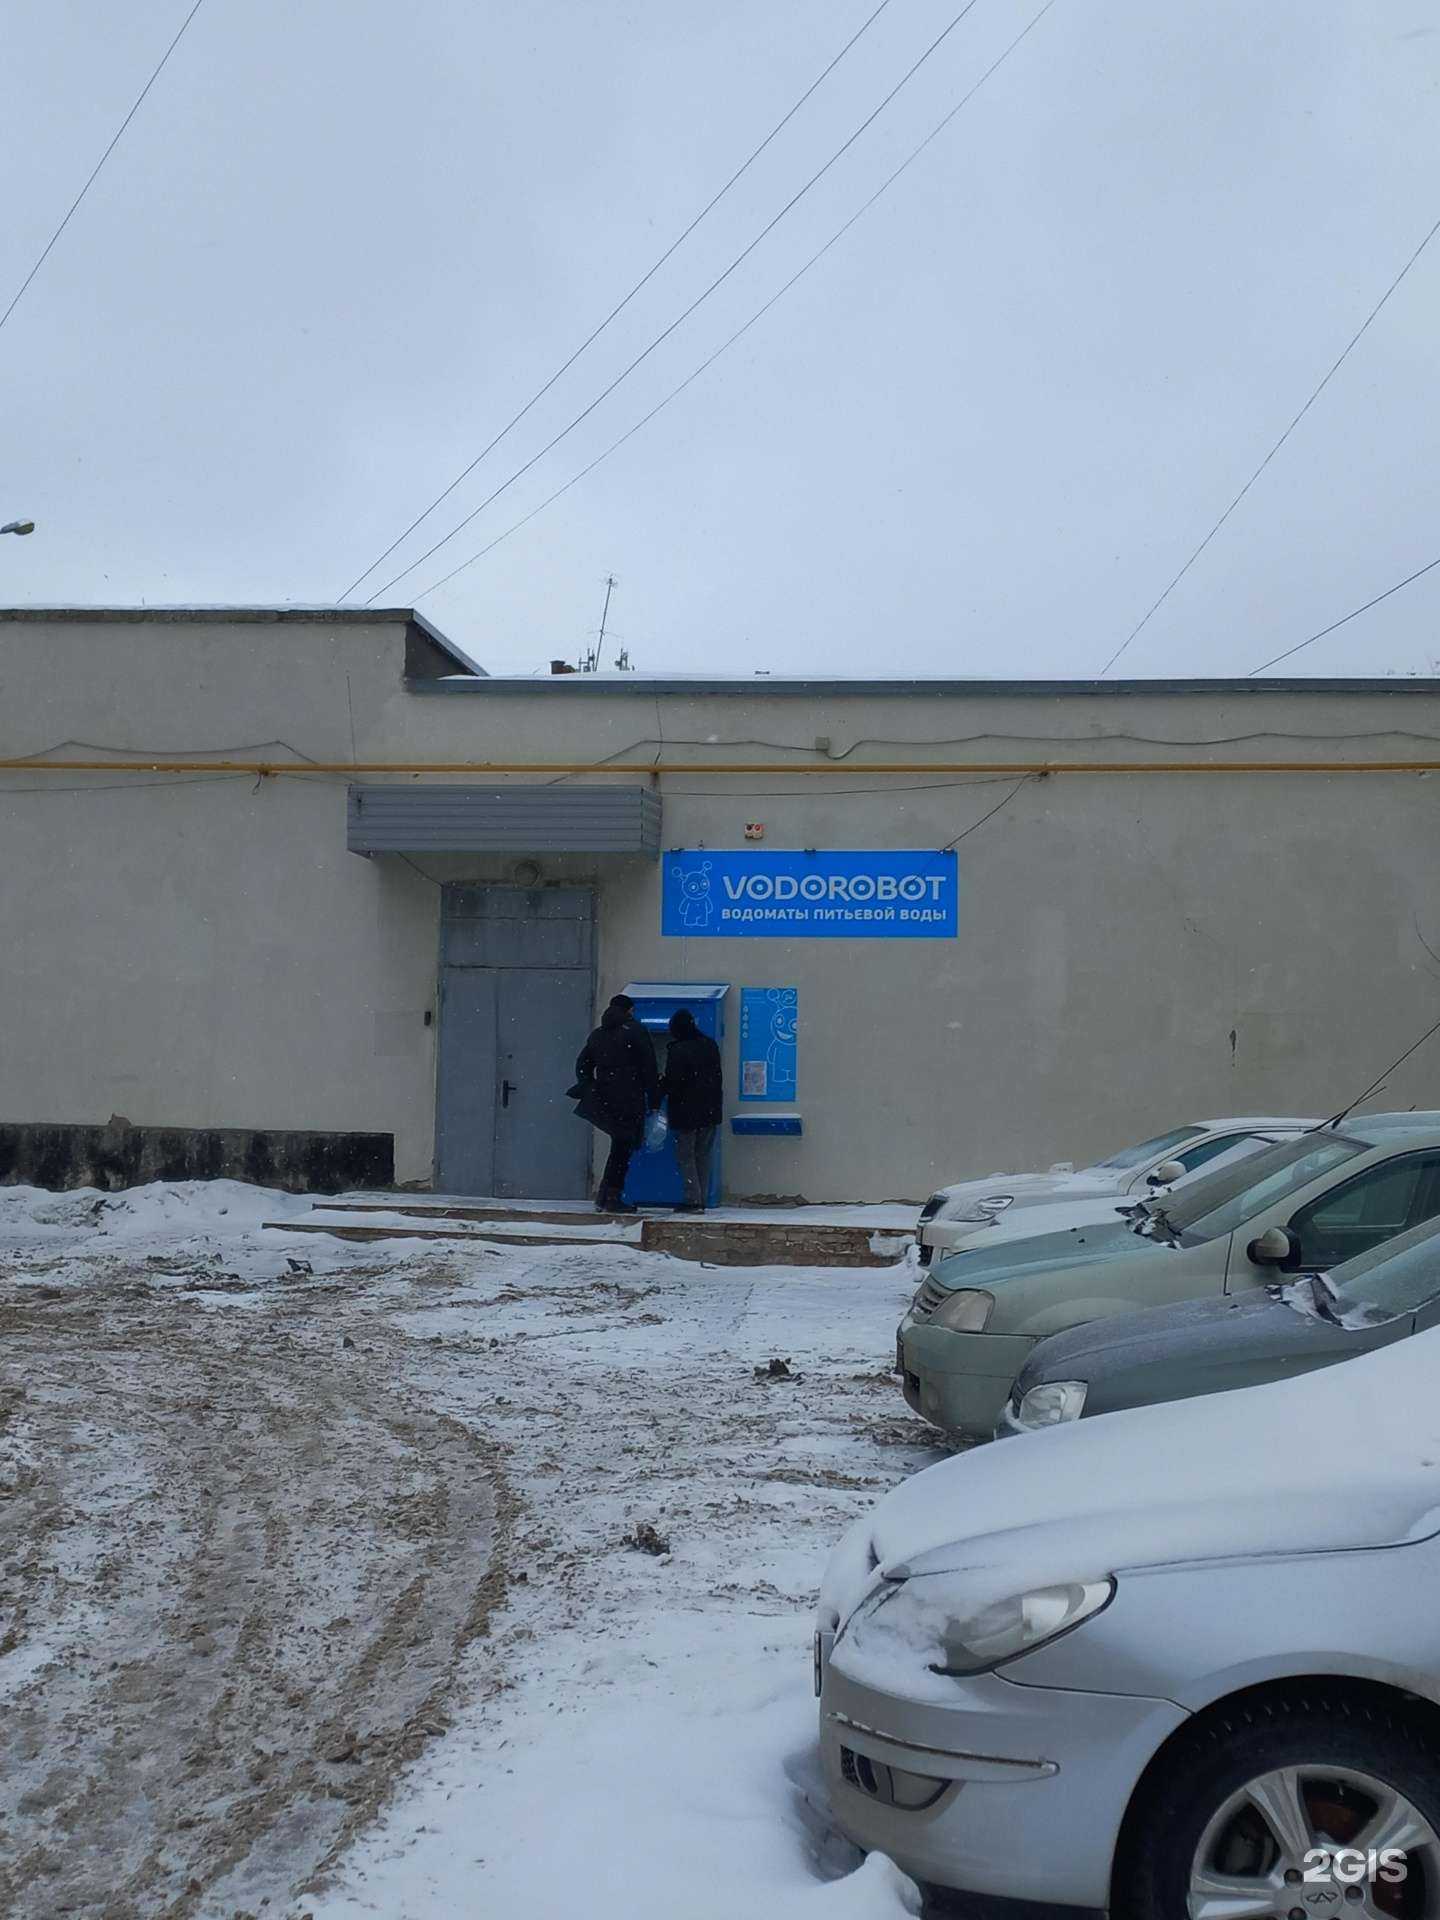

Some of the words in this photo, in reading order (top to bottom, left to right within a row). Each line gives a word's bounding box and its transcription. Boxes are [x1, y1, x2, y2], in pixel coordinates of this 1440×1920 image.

[722, 875, 947, 901] VODOROBOT
[721, 909, 809, 921] ВОДОМАТЫ
[813, 907, 895, 920] ПИТЬЕВОЙ
[900, 909, 947, 921] ВОДЫ
